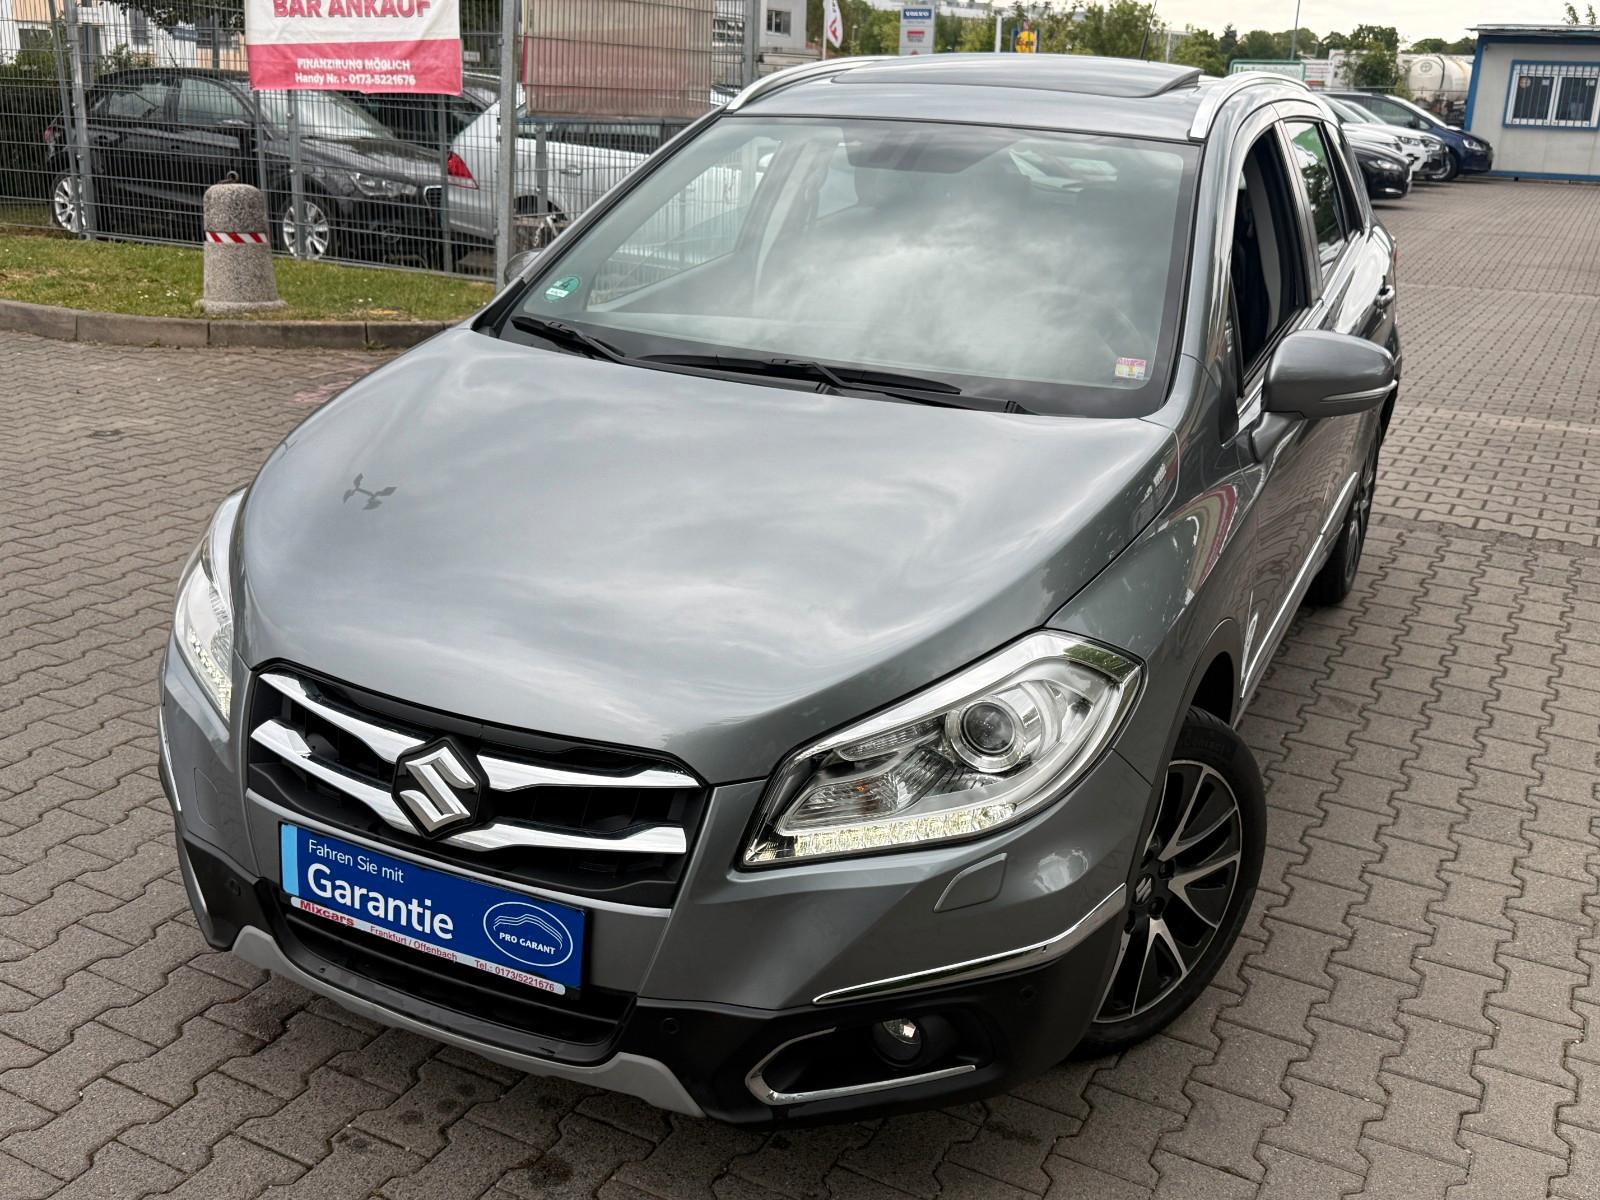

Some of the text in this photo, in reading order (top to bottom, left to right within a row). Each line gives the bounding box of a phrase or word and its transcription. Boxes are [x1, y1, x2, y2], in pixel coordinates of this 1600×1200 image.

[273, 0, 431, 18] BAR ANKAUF
[365, 57, 411, 70] MÖGLICH
[295, 73, 324, 86] Handy
[308, 839, 404, 884] Fahren Sie mit
[307, 862, 454, 940] Garantie
[300, 899, 355, 928] Mixcars
[370, 925, 407, 947] Frankfurt
[413, 941, 458, 962] Offenbach
[494, 966, 555, 992] 0173/5221676
[499, 932, 556, 955] PRO GARANT
